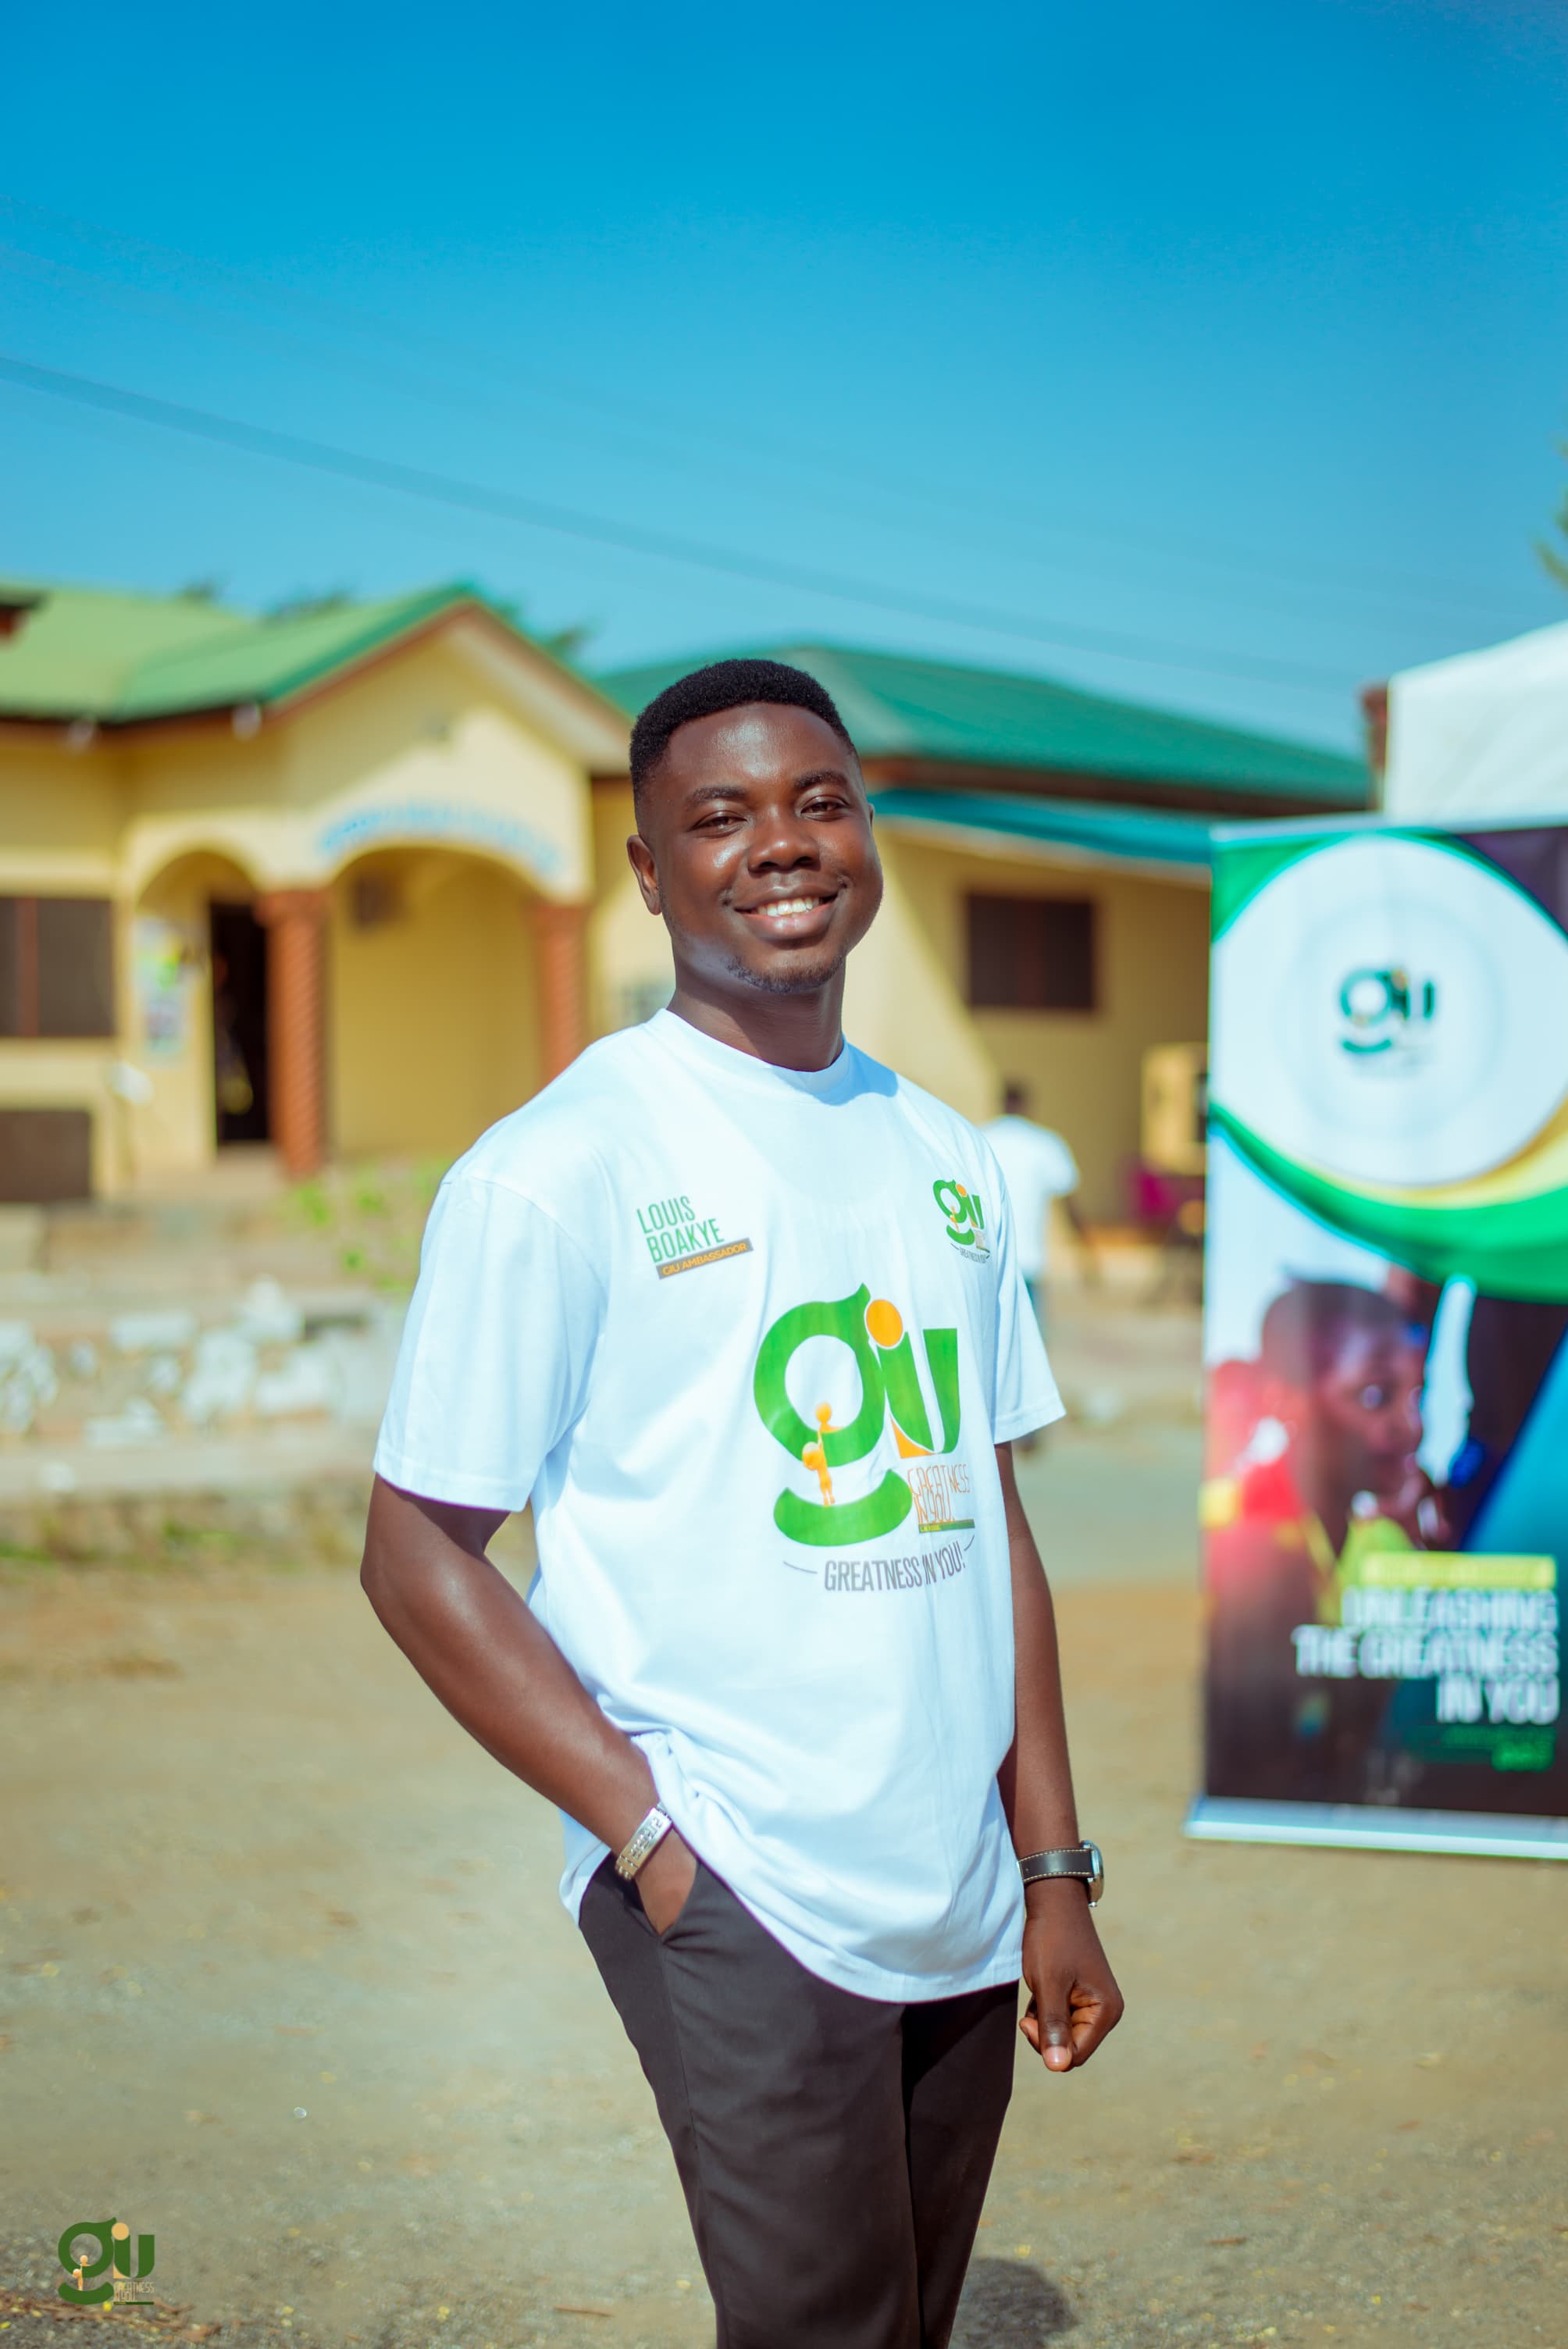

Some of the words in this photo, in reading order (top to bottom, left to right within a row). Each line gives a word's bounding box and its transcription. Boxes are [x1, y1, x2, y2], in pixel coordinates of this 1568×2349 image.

[636, 1196, 696, 1234] LOUIS
[646, 1218, 725, 1262] BOAKYE
[662, 1263, 680, 1275] GIU
[682, 1242, 747, 1269] AMBASSADOR
[907, 1463, 971, 1496] GREATNESS
[824, 1555, 922, 1592] GREATNESS
[921, 1552, 937, 1585] IN
[935, 1540, 966, 1580] YOU!
[1342, 1586, 1559, 1631] UNLEASHING
[1291, 1624, 1359, 1676] THE
[1359, 1627, 1559, 1678] GREATNESS
[1437, 1672, 1482, 1723] IN
[1483, 1674, 1560, 1725] YOU
